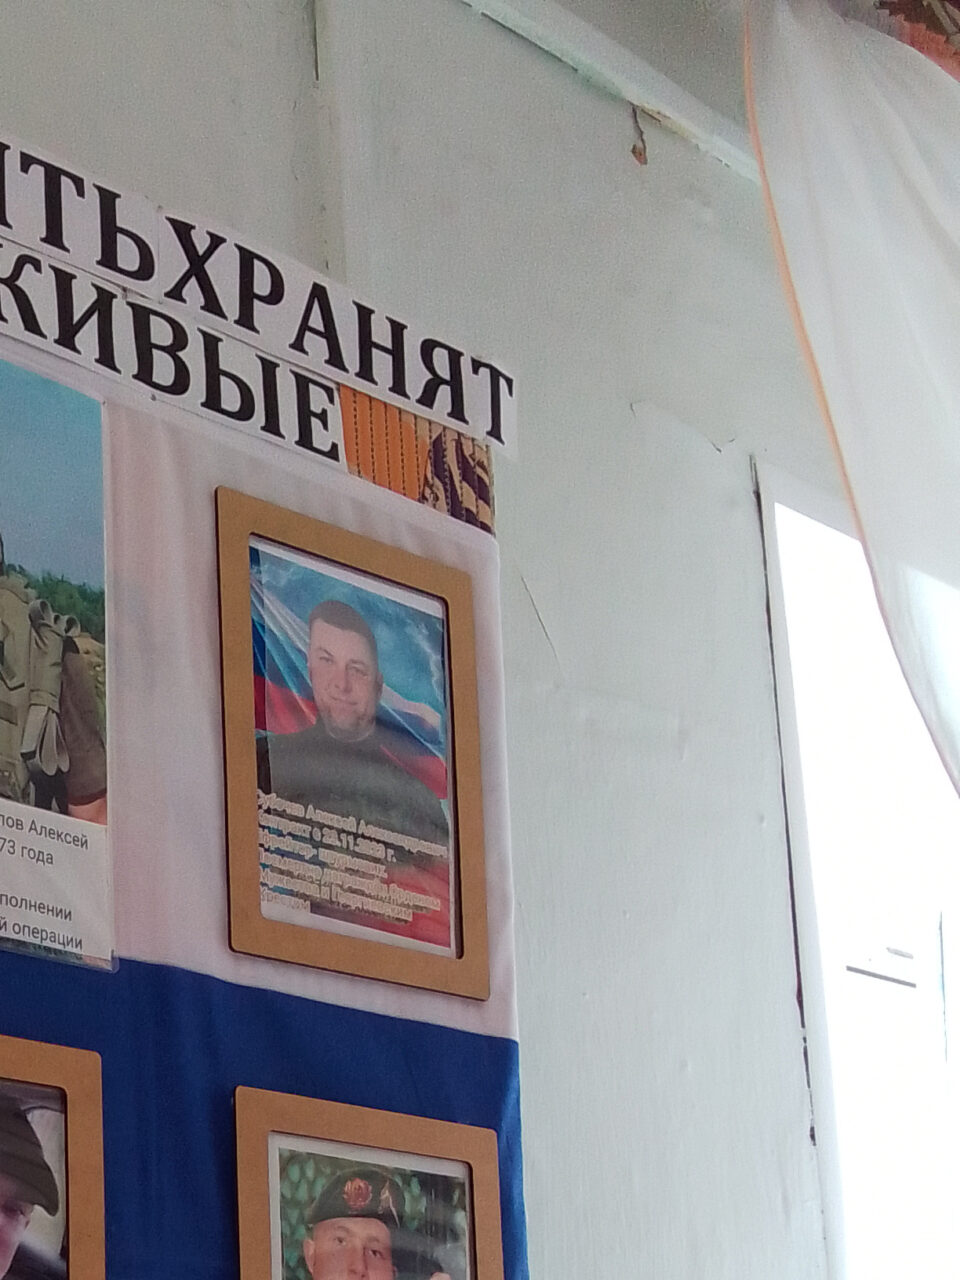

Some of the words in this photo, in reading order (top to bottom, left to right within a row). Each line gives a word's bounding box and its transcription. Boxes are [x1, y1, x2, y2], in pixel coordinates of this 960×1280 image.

[28, 819, 88, 850] Алексей
[20, 844, 54, 867] года
[12, 922, 83, 951] операции
